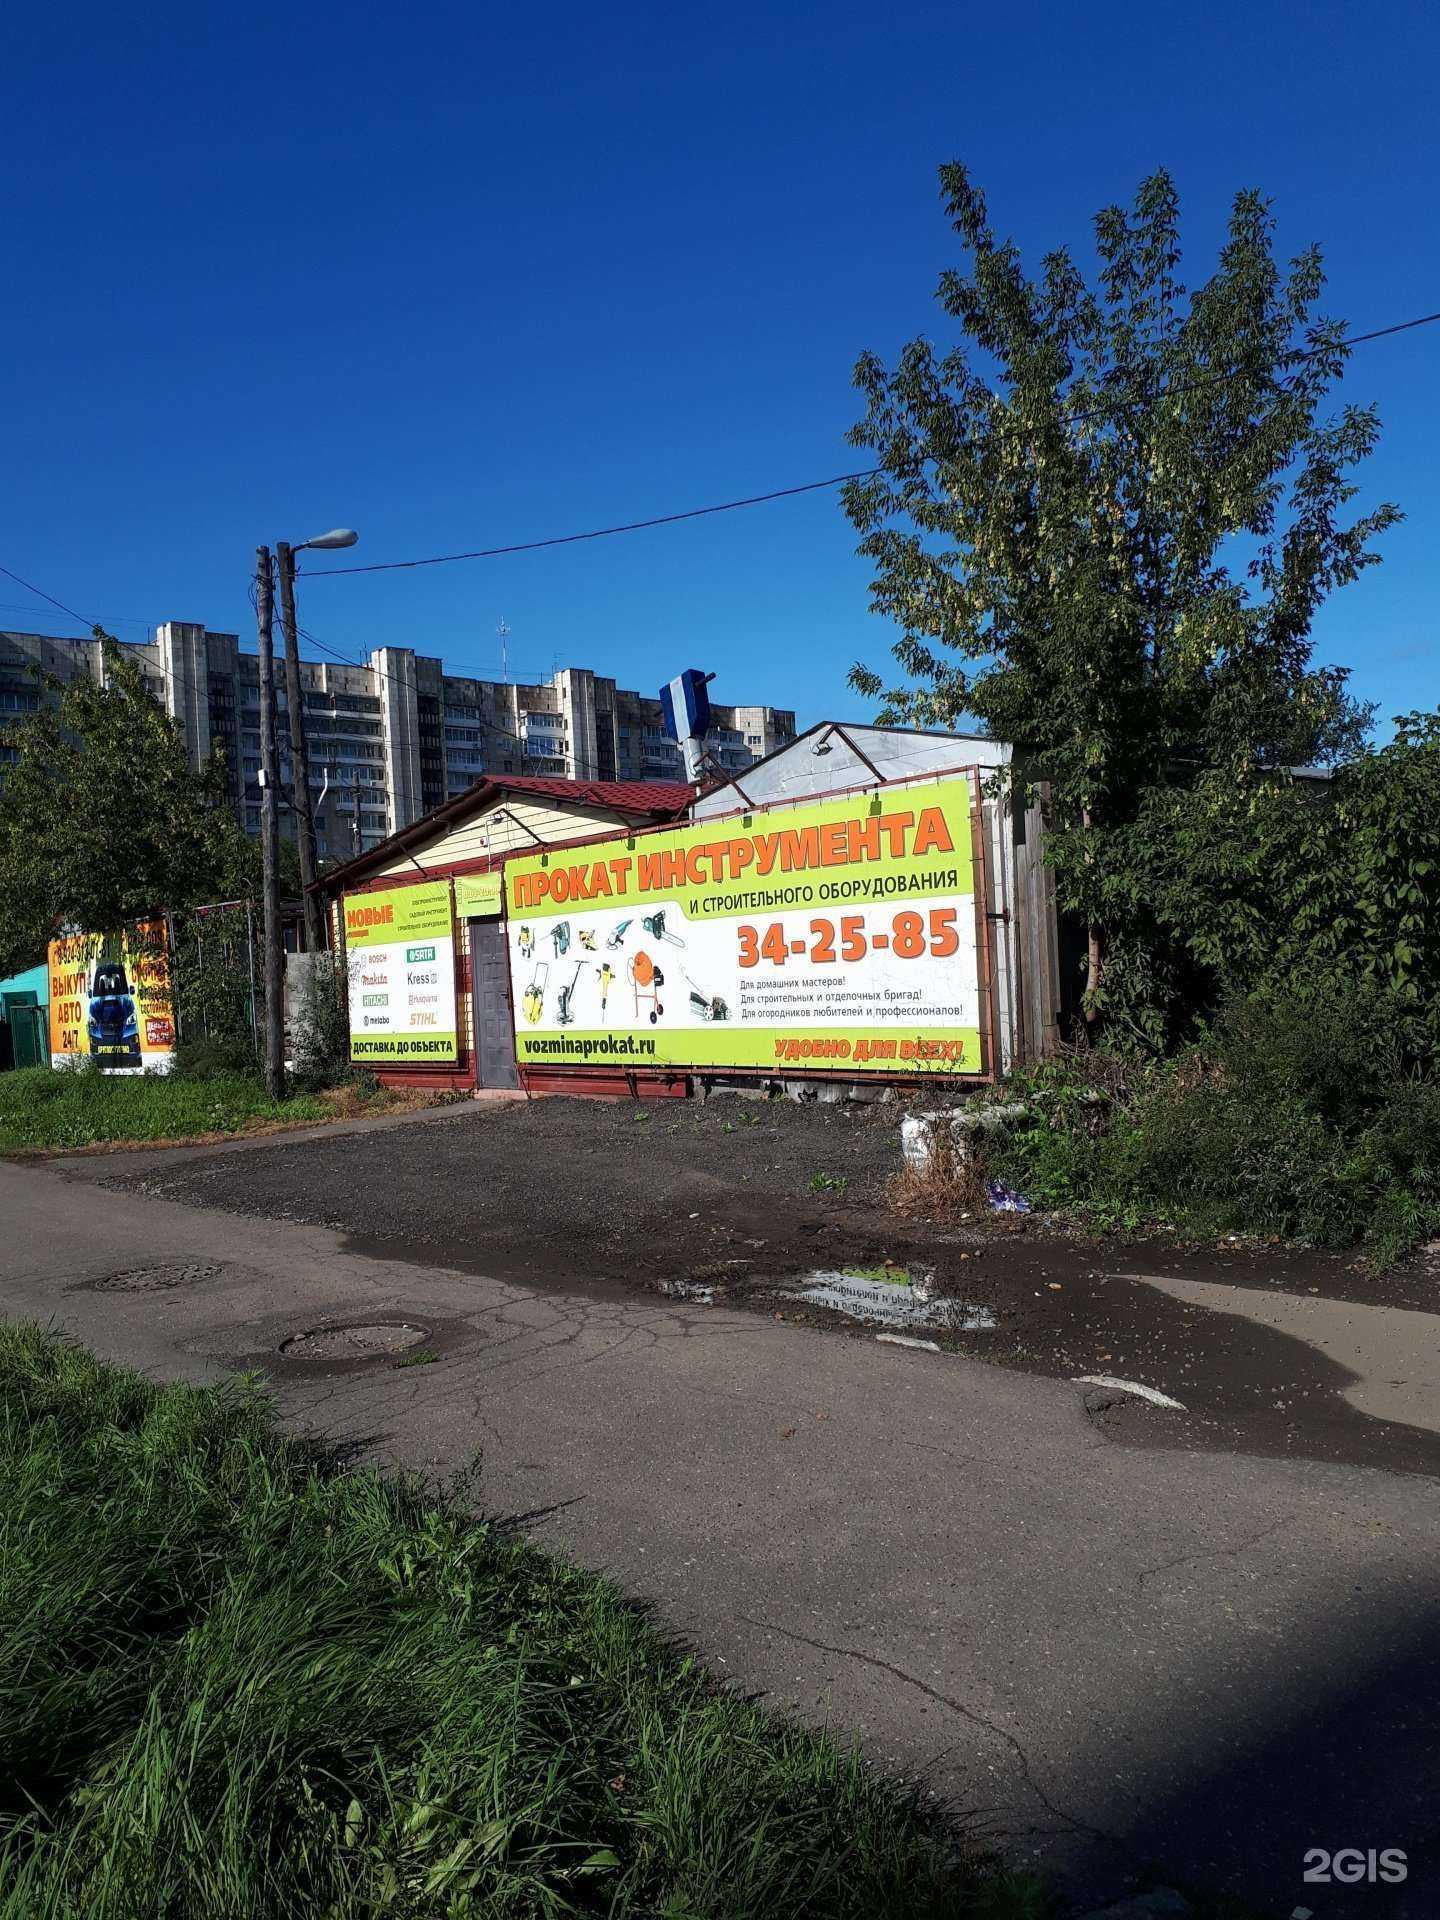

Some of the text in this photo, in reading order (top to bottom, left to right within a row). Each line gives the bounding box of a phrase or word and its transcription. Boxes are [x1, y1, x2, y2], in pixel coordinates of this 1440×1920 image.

[513, 806, 956, 909] ПРОКАТ ИНСТРУМЕНТА
[690, 870, 958, 914] И СТРОИТЕЛЬНОГО ОБОРУДОВАНИЯ
[347, 904, 394, 928] НОВЫЕ
[737, 908, 960, 967] 34-25-85
[52, 973, 86, 997] ВЫКУП
[407, 971, 429, 985] Kress
[740, 976, 846, 991] Для домашних мастеров!
[741, 994, 755, 1005] Для
[757, 993, 814, 1004] строительных
[825, 991, 881, 1002] отделочных
[884, 989, 922, 1002] бригад!
[58, 1001, 81, 1023] АВТО
[370, 1016, 390, 1024] metabo
[409, 1012, 437, 1025] STIHL
[741, 1005, 963, 1019] Для огородников любителей и профессионалов!
[63, 1030, 79, 1048] 24/7
[353, 1040, 453, 1054] ДОСТАВКА ДО ОБЪЕКТА
[524, 1034, 655, 1058] vozminaprokat.ru
[775, 1039, 964, 1061] УДОБНО ДЛЯ ВСЕХ!
